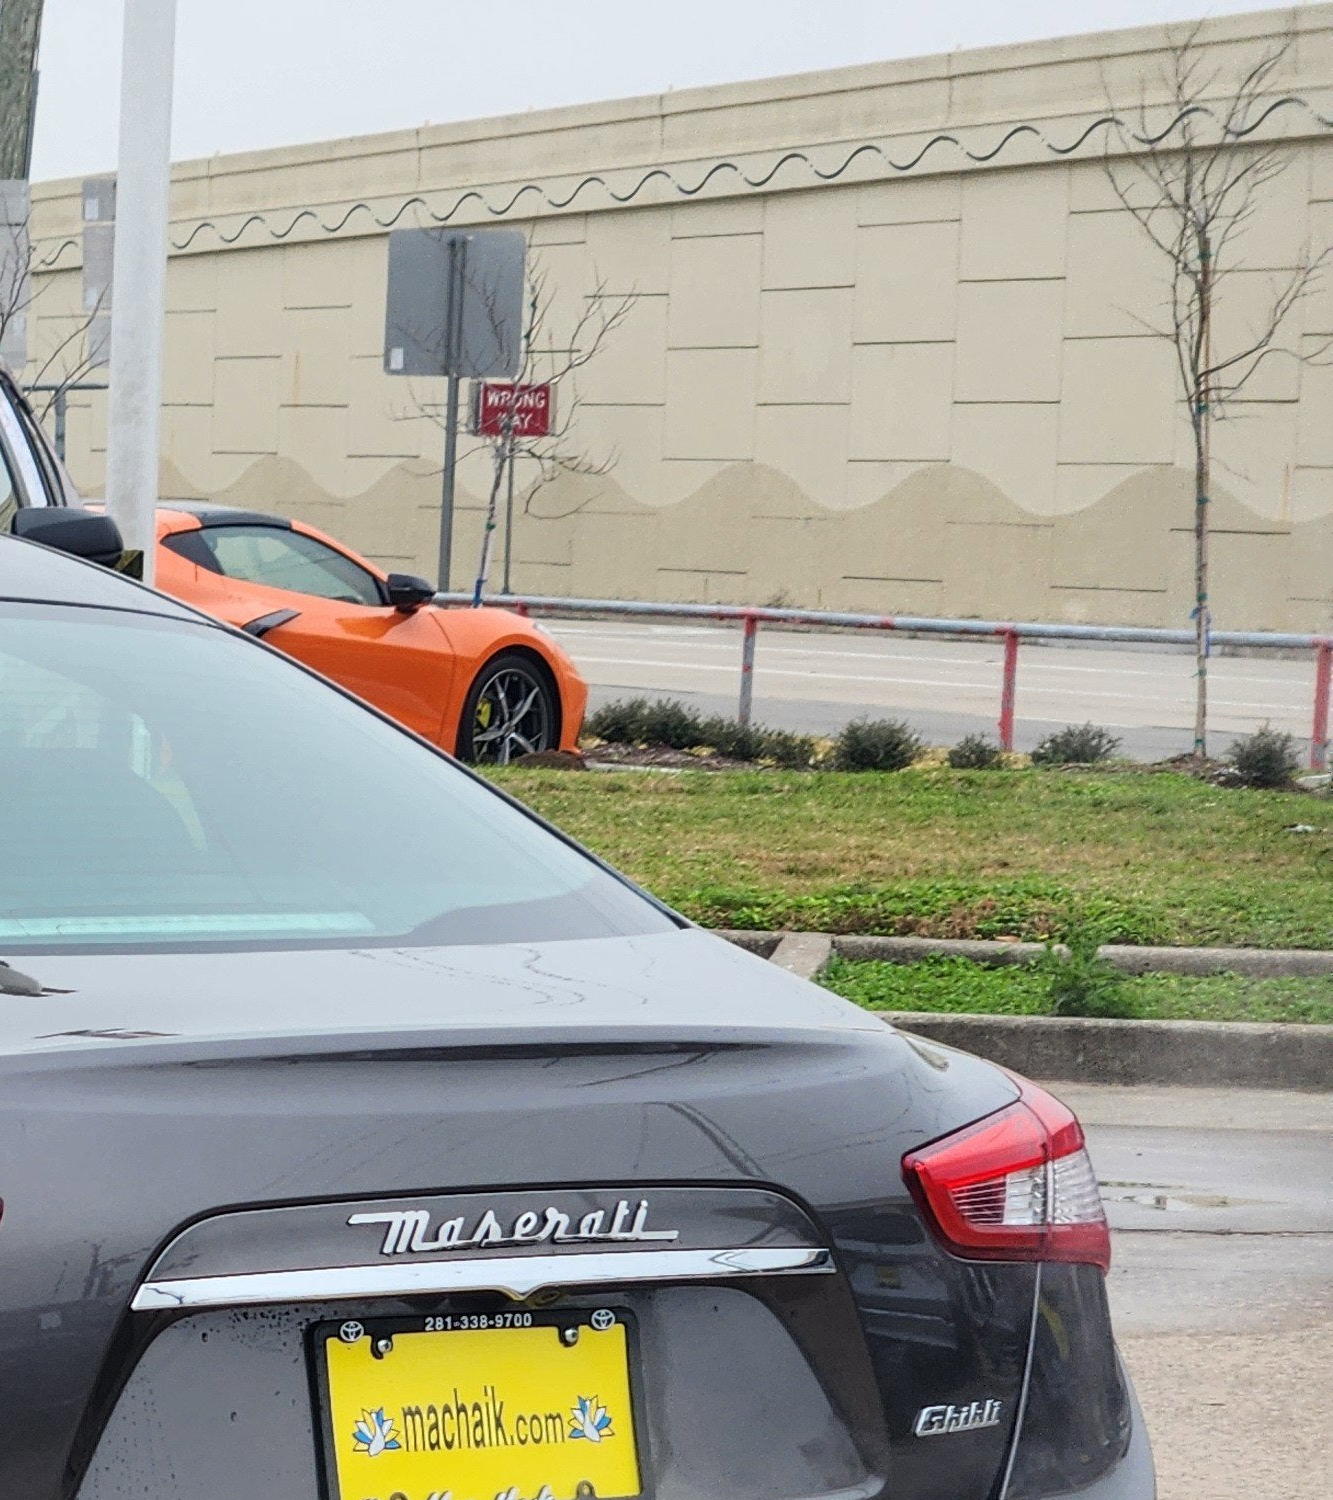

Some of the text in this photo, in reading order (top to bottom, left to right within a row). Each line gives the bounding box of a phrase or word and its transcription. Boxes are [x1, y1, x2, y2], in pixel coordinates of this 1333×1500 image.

[347, 1199, 680, 1255] Maserati
[424, 1312, 533, 1332] 281-338-9700
[401, 1384, 567, 1453] machaik.com
[915, 1398, 1003, 1437] Ghibli
